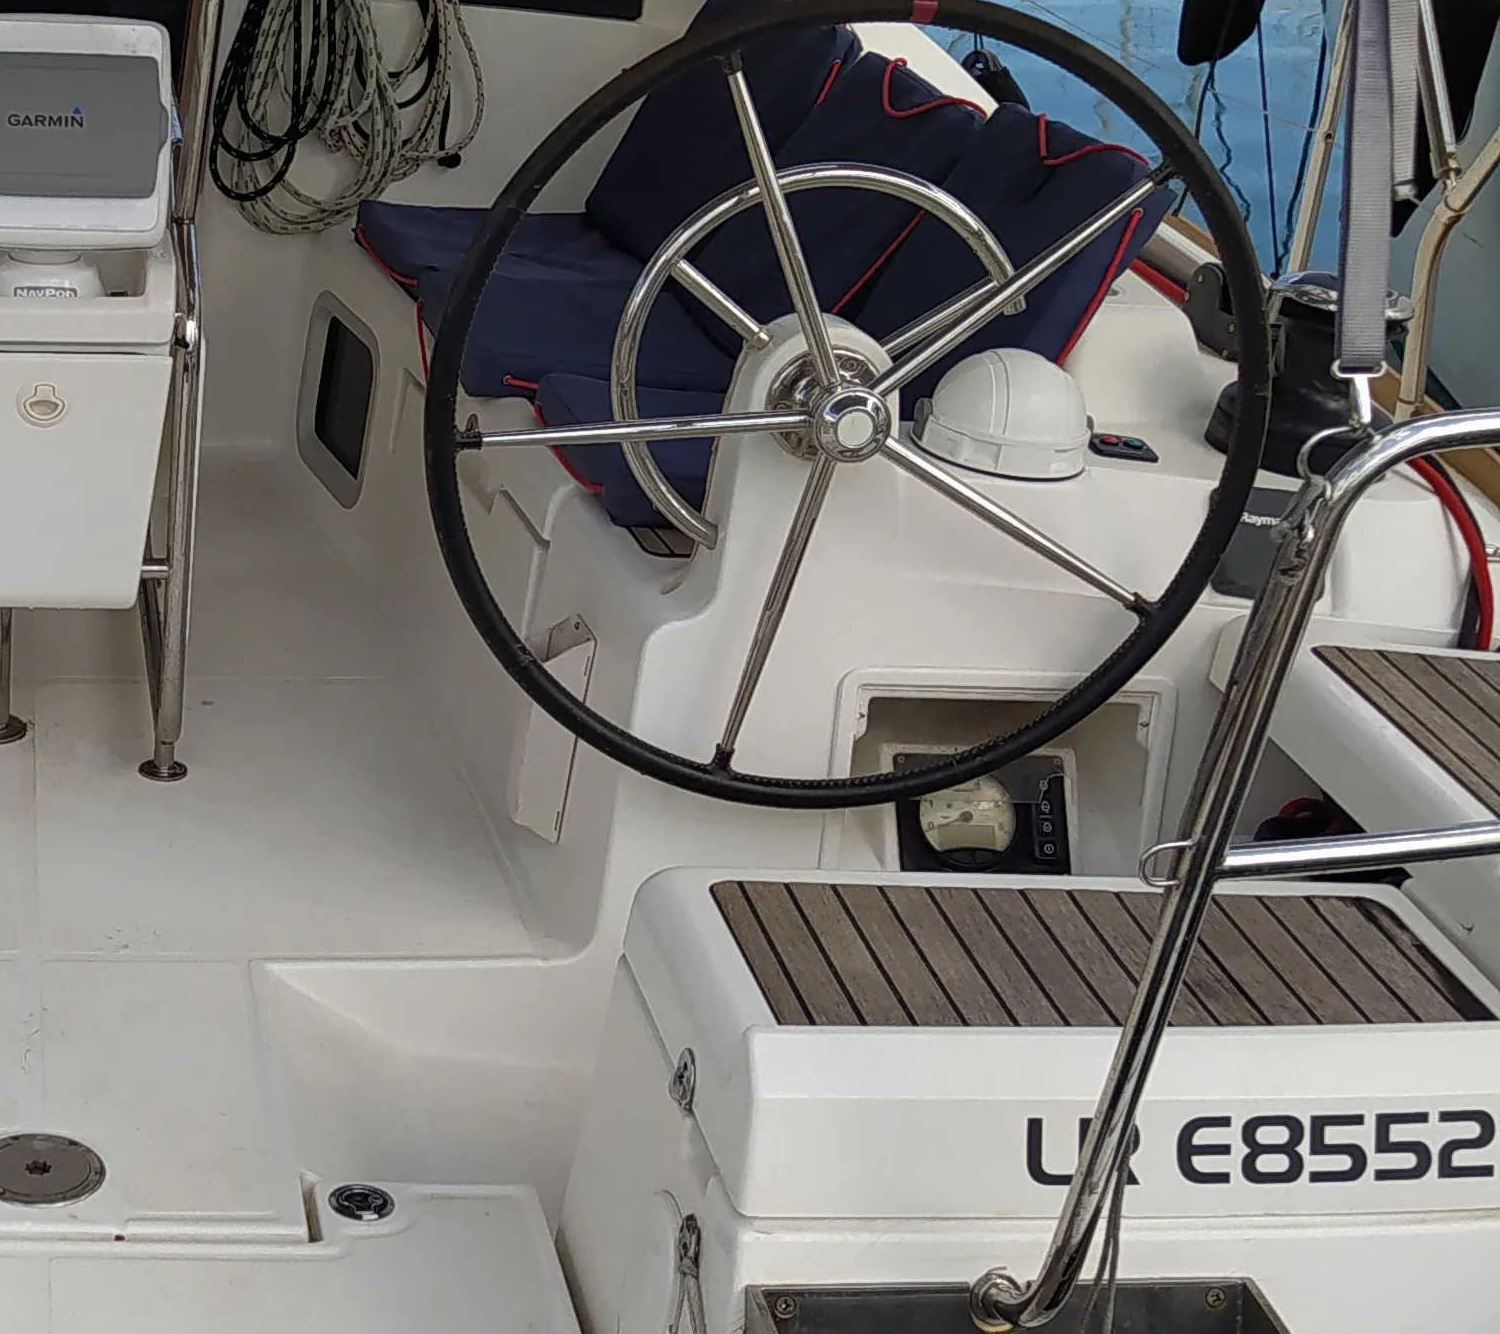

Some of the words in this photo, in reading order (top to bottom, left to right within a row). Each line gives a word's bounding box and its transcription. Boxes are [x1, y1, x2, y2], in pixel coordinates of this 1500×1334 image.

[7, 113, 84, 128] GARMIN
[1241, 512, 1281, 526] Rayma
[1176, 1110, 1496, 1184] E8552
